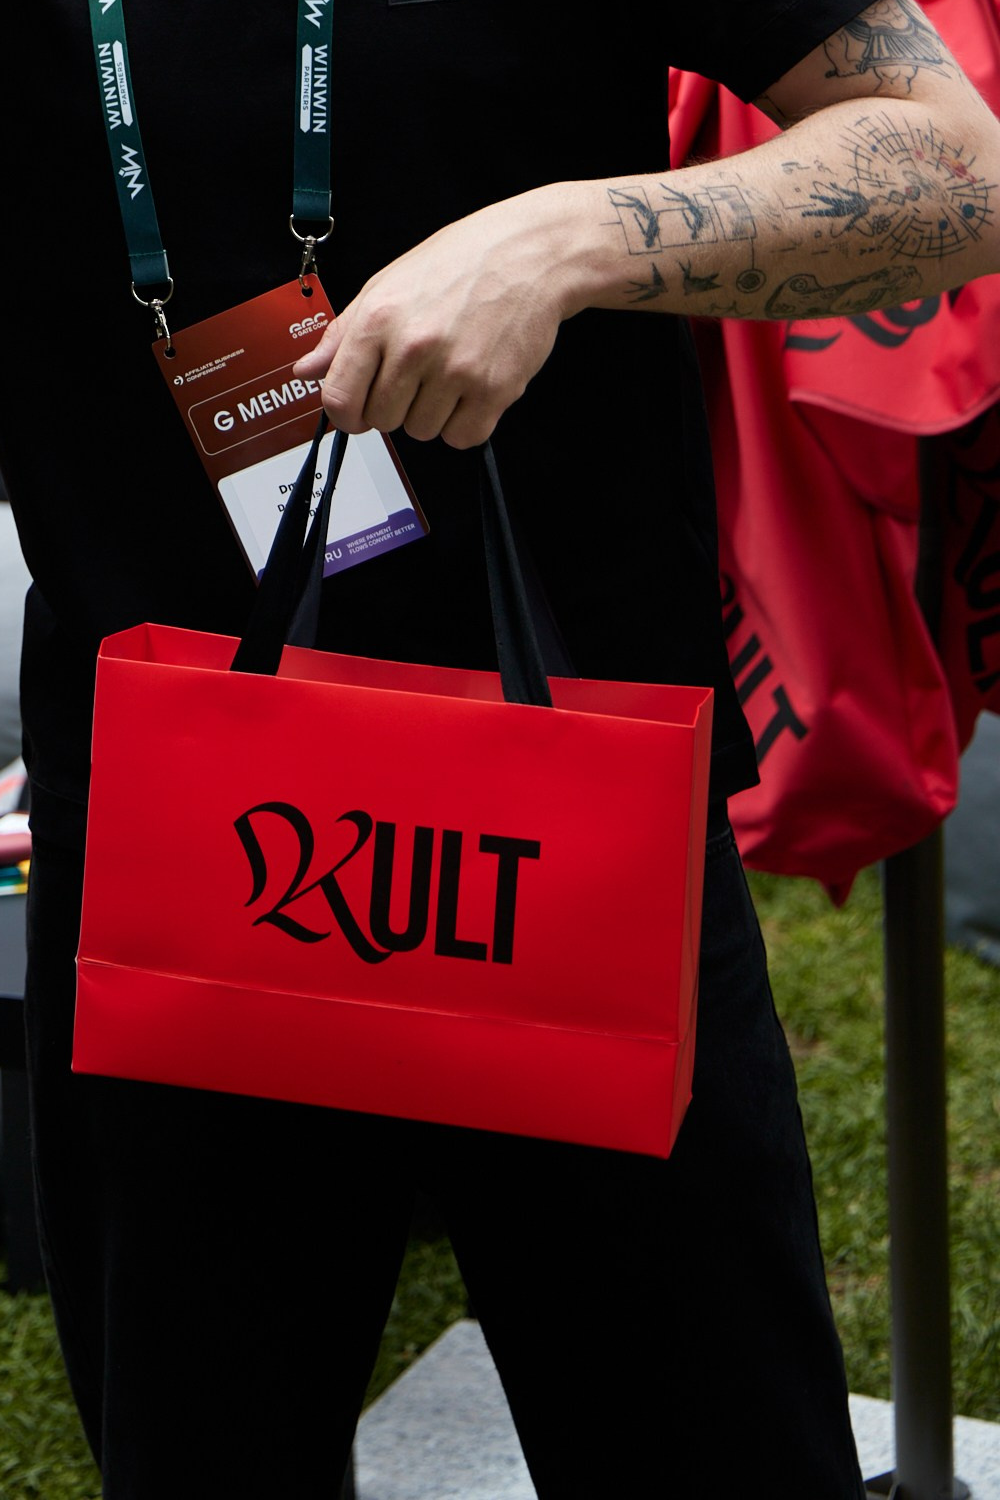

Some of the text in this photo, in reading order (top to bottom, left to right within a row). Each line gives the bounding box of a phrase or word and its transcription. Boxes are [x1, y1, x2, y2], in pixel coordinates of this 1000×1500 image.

[97, 42, 122, 131] WINWIN
[116, 61, 128, 105] PARTNERS
[302, 66, 310, 111] PARTNERS
[312, 43, 328, 133] WINWIN
[184, 362, 214, 378] AFFILIATE
[186, 362, 227, 383] CONFERENCE
[213, 378, 326, 432] G MEMBE
[346, 526, 392, 549] WHERE PAYMENT
[349, 543, 369, 555] FLOWS
[369, 532, 395, 547] CONVERT
[395, 523, 416, 537] BETTER
